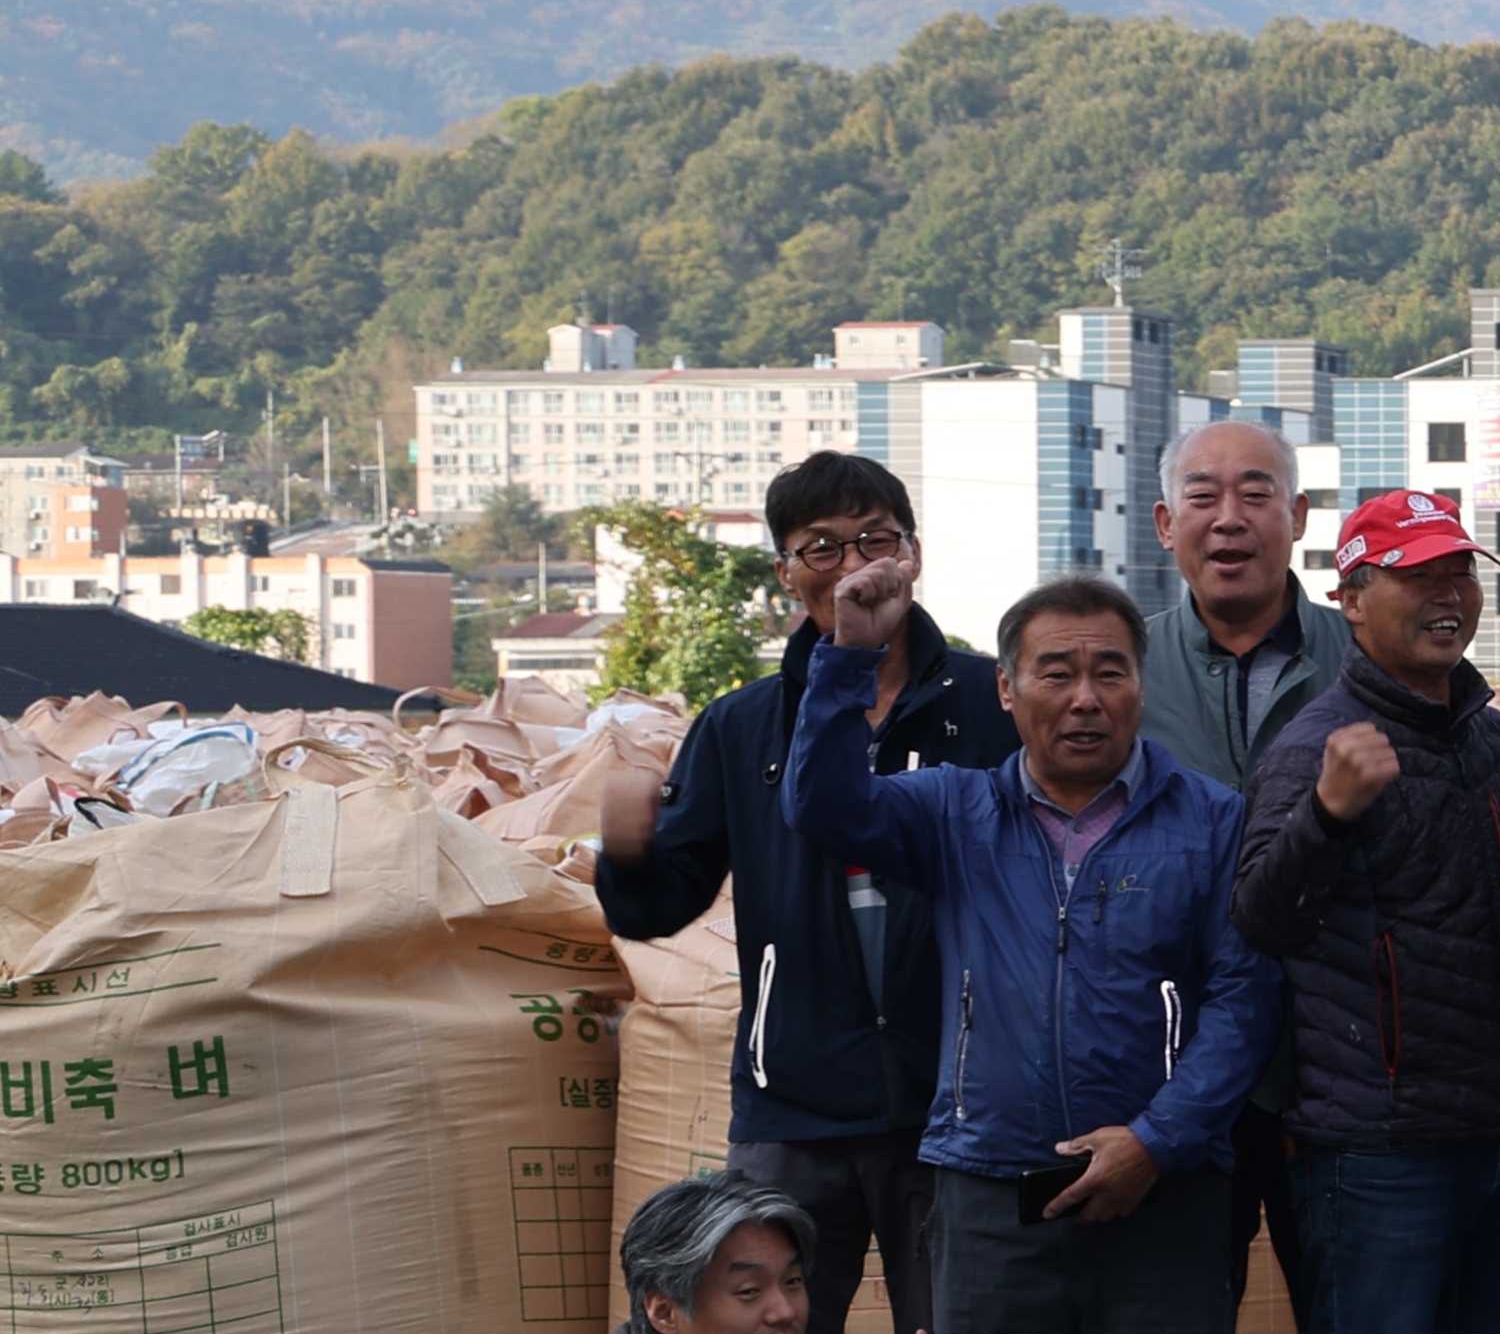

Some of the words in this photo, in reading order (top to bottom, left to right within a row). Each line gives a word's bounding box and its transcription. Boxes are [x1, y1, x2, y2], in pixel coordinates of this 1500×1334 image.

[0, 1058, 118, 1124] 비축
[167, 1035, 230, 1100] 벼
[559, 1076, 617, 1108] [실중
[61, 1148, 185, 1188] 800kg]
[183, 1212, 241, 1237] 검사표시
[226, 1227, 268, 1249] 검사원
